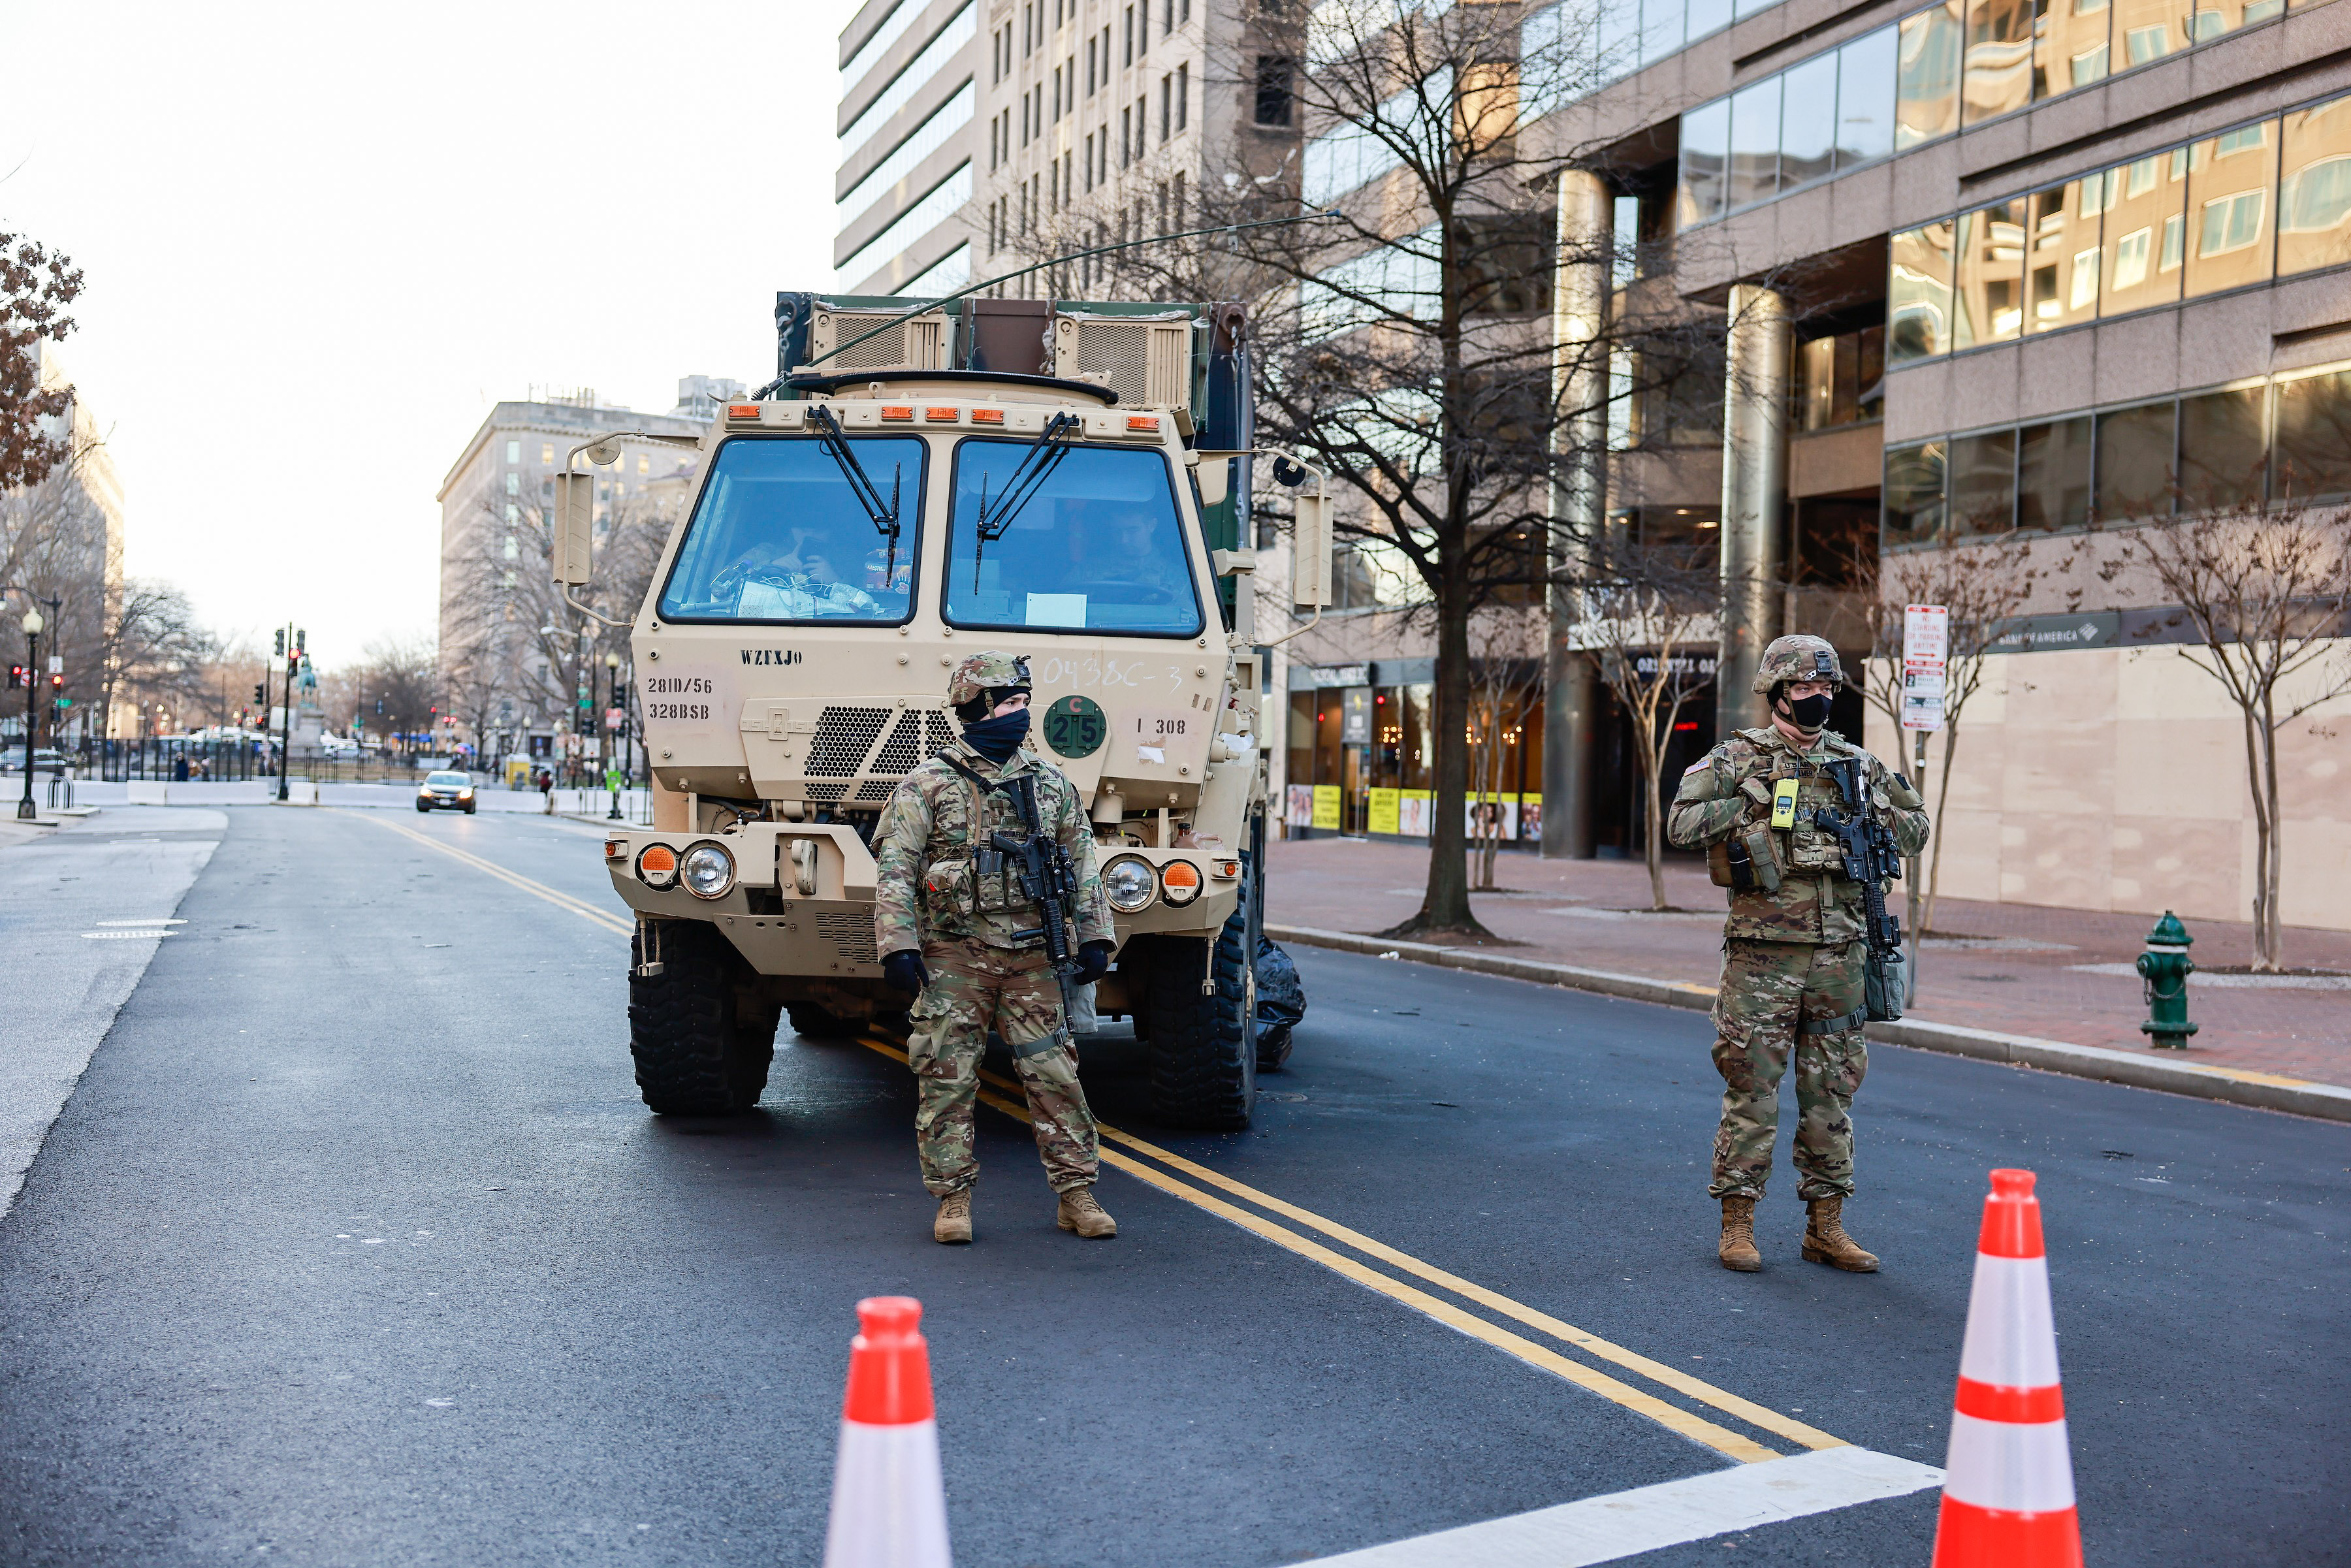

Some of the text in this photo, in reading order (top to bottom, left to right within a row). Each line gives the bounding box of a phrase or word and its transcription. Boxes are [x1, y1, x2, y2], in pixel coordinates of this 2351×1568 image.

[1912, 623, 1939, 632] STANDING
[1998, 633, 2023, 645] BANK
[2036, 630, 2078, 643] AMERICA
[1906, 675, 1915, 686] 2
[649, 703, 709, 719] 328BSB
[1069, 697, 1083, 712] C
[1155, 719, 1185, 735] 308
